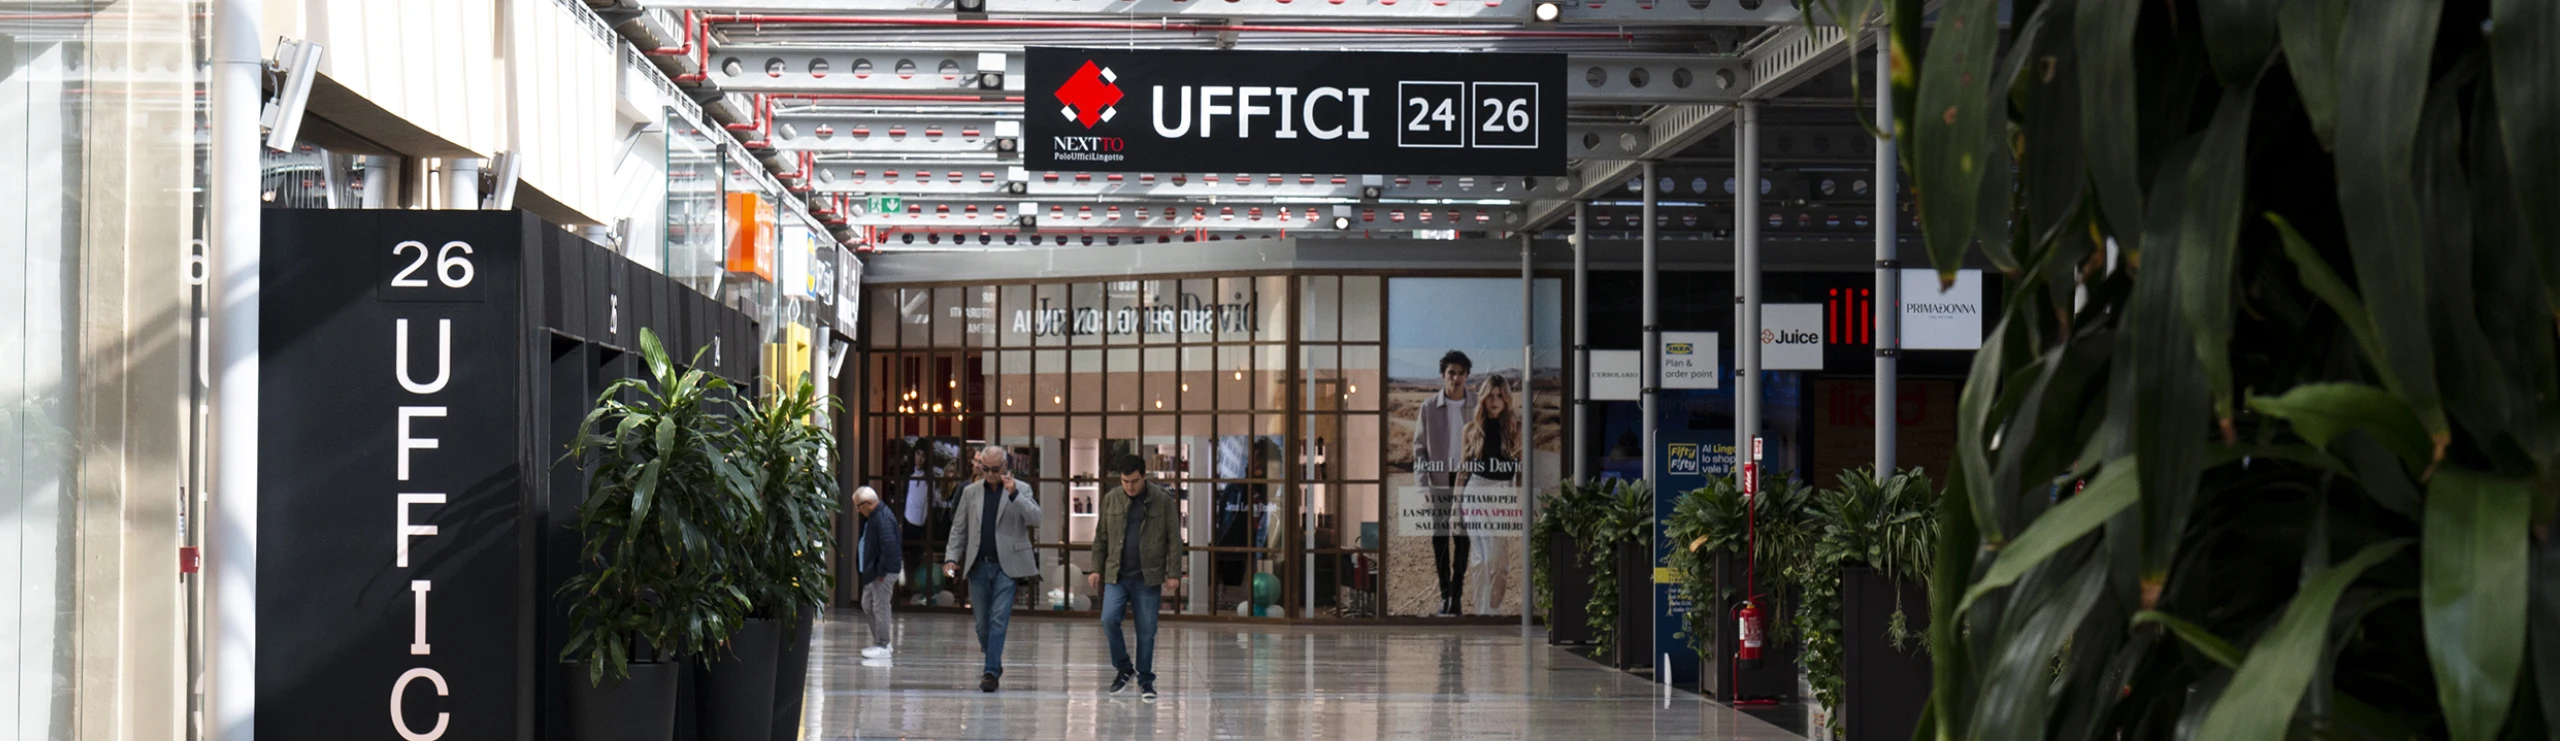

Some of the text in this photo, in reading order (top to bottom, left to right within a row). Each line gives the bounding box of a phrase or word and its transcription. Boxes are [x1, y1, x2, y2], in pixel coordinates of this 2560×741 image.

[1152, 85, 1530, 140] UFFICI 24 26
[1054, 152, 1124, 162] PoloUfficiLingotto
[390, 240, 475, 288] 26
[1906, 302, 1976, 314] PRIMADONNA
[1829, 288, 1876, 344] ili
[1775, 329, 1819, 344] Juice
[1665, 359, 1693, 368] Plan &
[1665, 370, 1713, 380] order point
[1701, 444, 1712, 453] Al
[1414, 457, 1444, 472] Jean
[1449, 457, 1485, 472] Louis
[1702, 454, 1711, 463] lo
[1671, 459, 1696, 471] Fifty
[1701, 464, 1722, 473] vale
